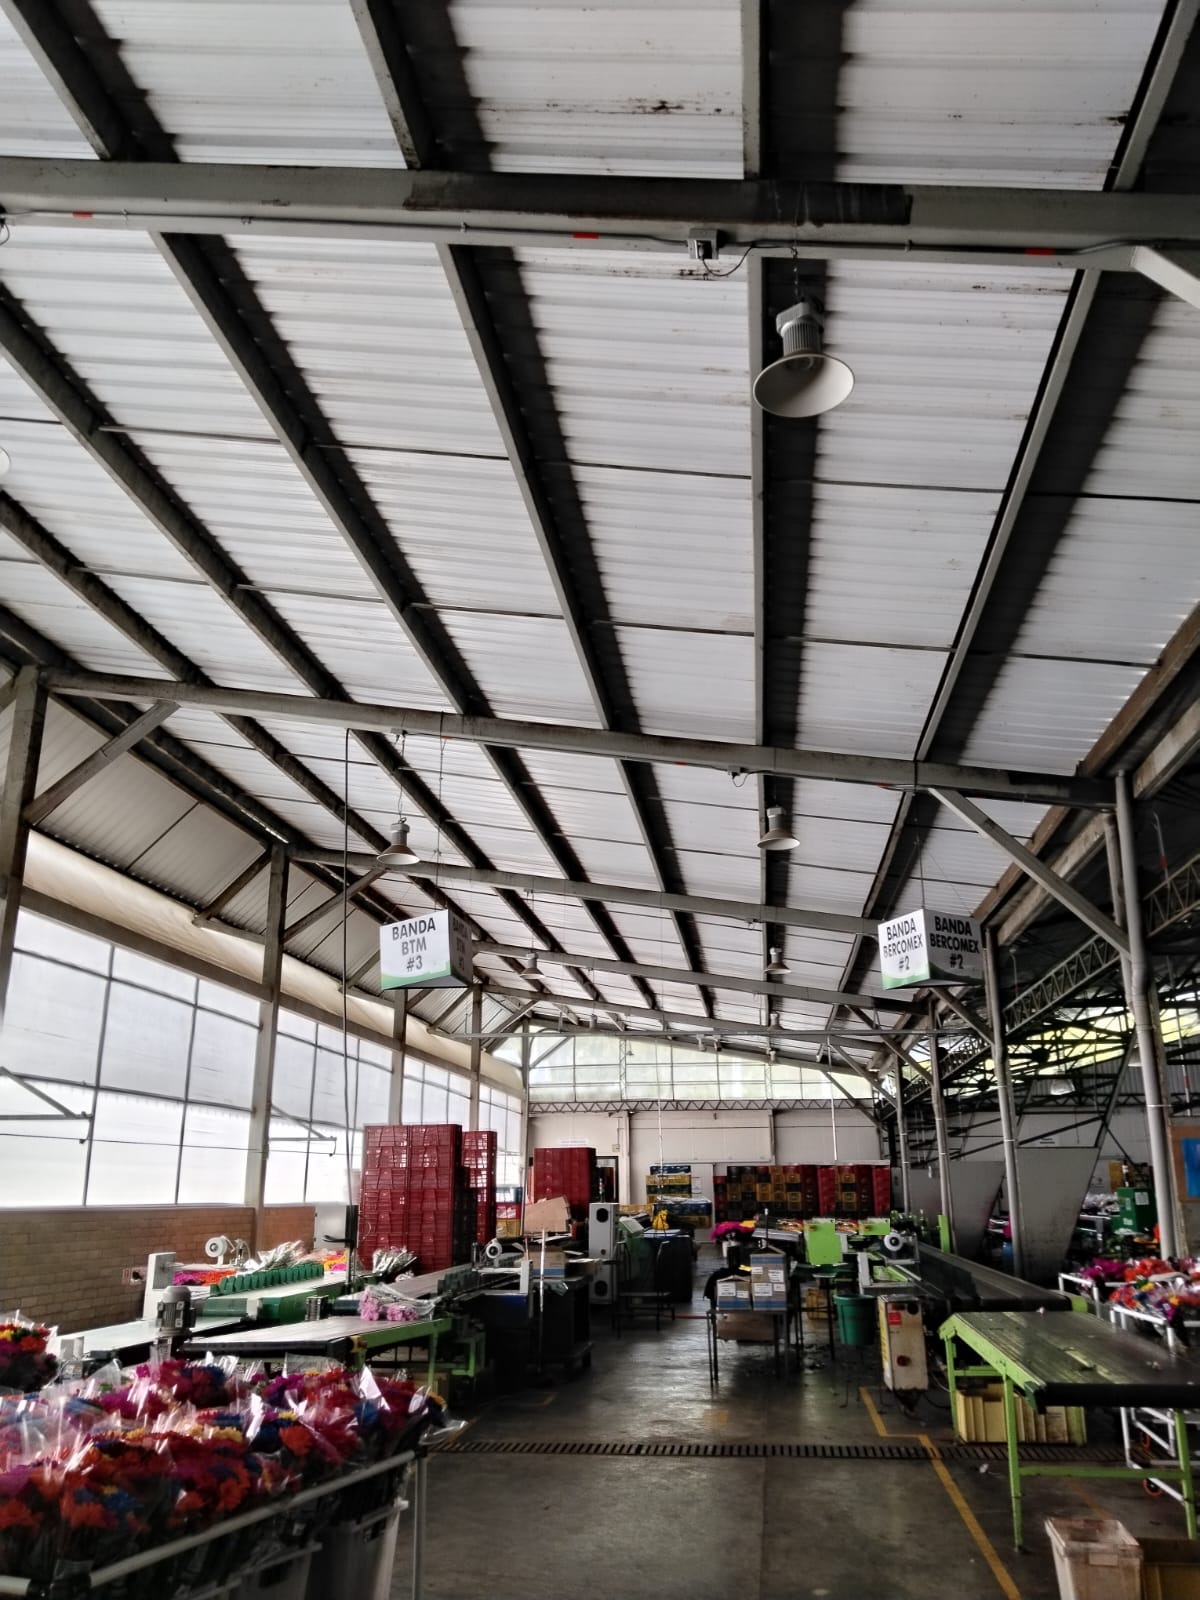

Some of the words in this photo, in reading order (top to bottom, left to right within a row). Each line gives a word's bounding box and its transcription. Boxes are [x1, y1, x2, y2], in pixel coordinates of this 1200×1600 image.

[392, 917, 436, 941] BANDA
[886, 917, 917, 941] BANDA
[934, 916, 973, 937] BANDA
[401, 936, 427, 956] BTM
[883, 934, 924, 958] BERCOMEX
[929, 933, 980, 954] BERCOMEX
[406, 955, 423, 973] #3
[898, 955, 910, 971] #2
[949, 953, 964, 969] #2
